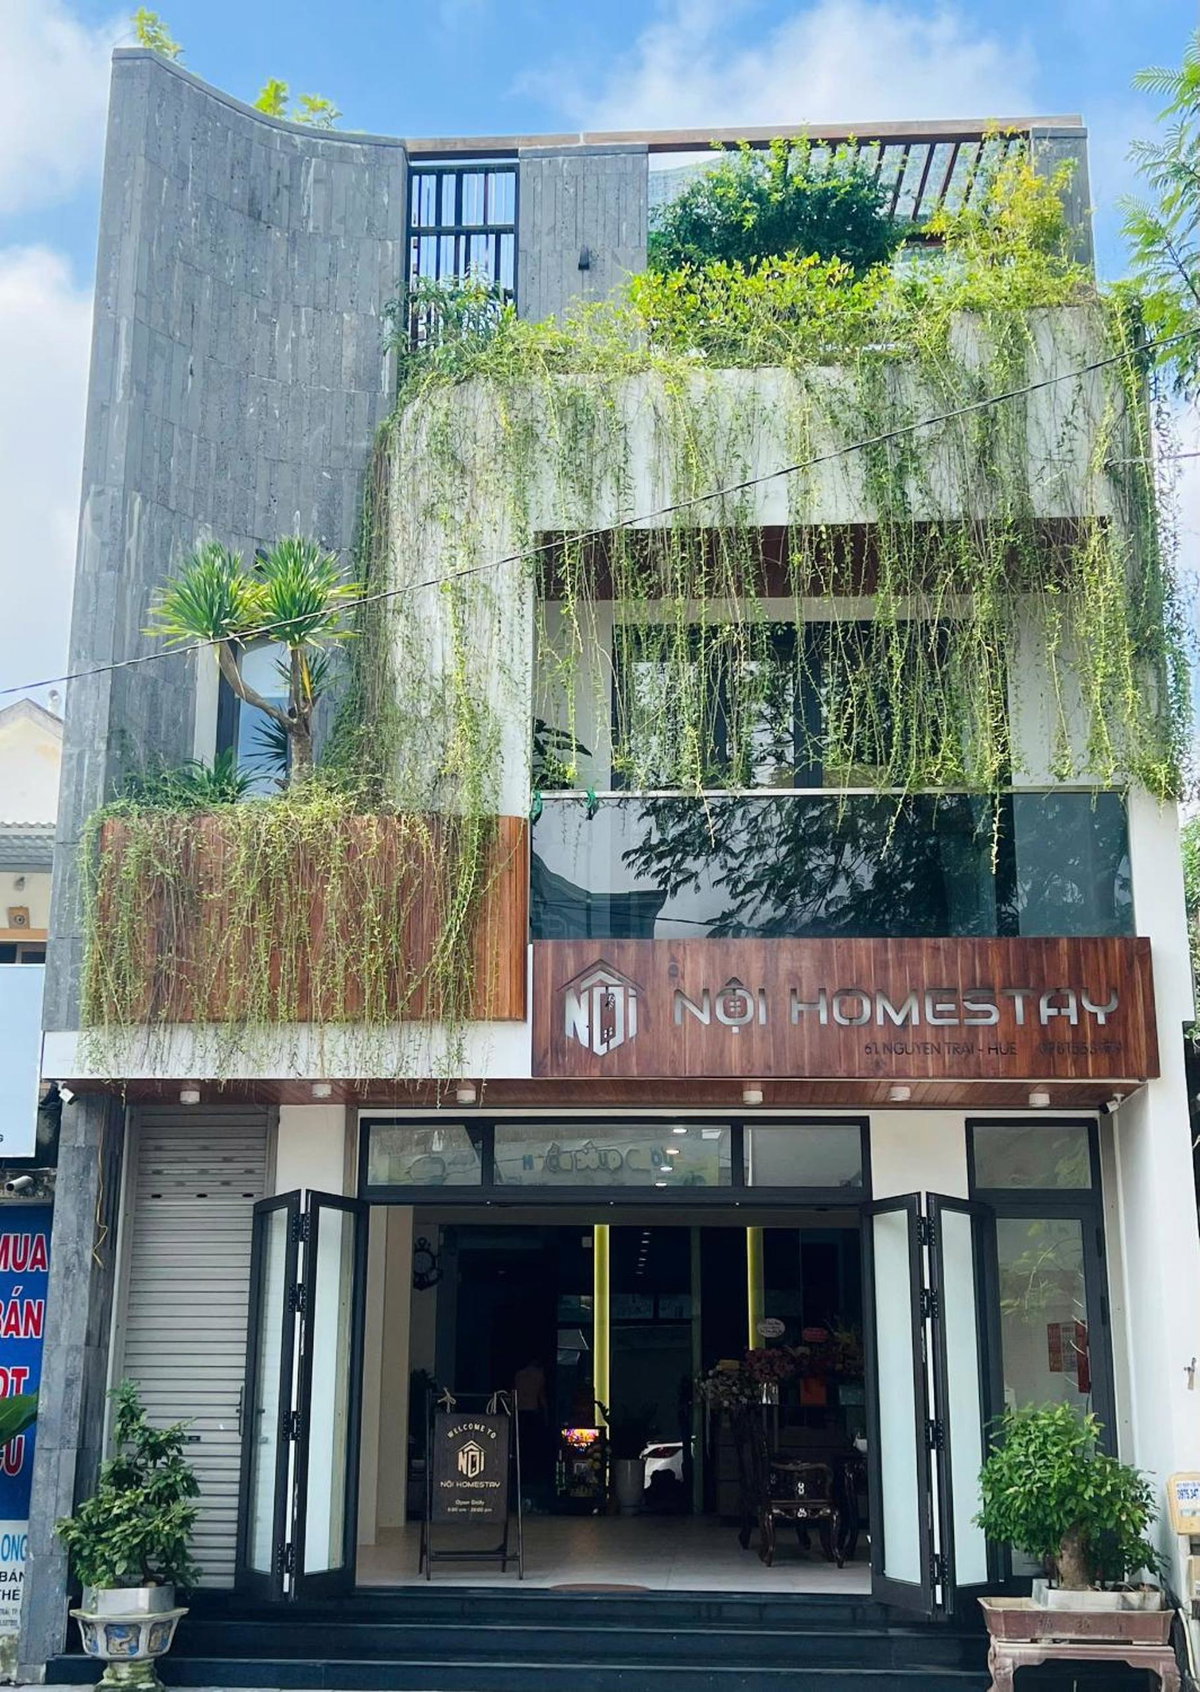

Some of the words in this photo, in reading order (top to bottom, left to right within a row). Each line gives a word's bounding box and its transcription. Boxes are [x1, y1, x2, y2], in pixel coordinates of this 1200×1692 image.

[674, 977, 767, 1034] NỘI
[790, 988, 1119, 1026] HOMESTAY
[864, 1042, 880, 1055] 61
[0, 1286, 45, 1338] ÁN
[447, 1422, 486, 1438] WELCOME
[487, 1428, 497, 1439] TO
